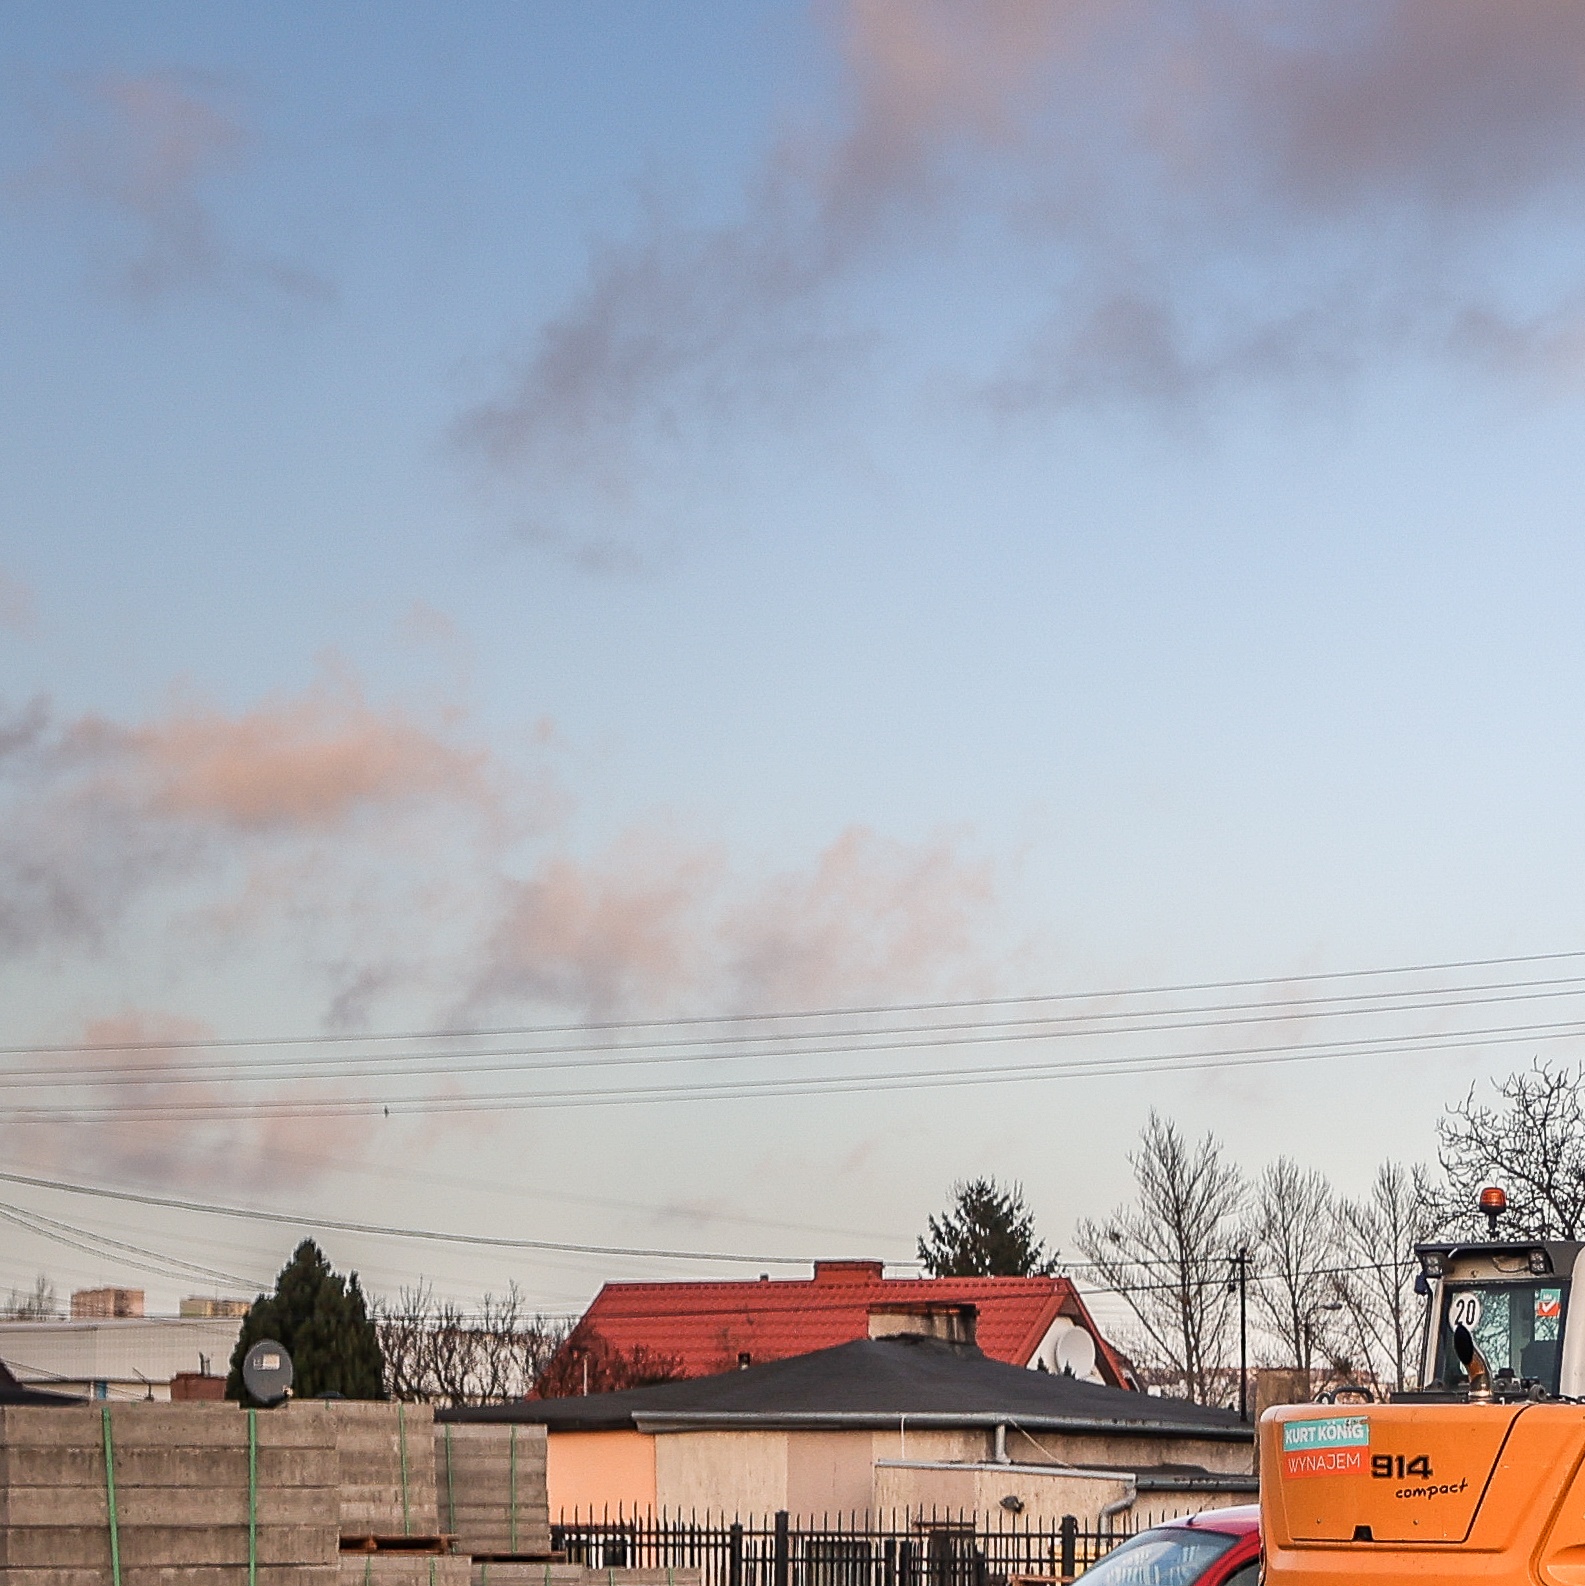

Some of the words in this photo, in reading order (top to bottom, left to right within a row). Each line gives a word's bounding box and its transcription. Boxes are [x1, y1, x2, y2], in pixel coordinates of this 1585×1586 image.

[1454, 1298, 1476, 1326] 20
[1285, 1426, 1316, 1444] KURT
[1287, 1452, 1360, 1473] WYNAJEM
[1371, 1454, 1433, 1480] 914
[1395, 1477, 1468, 1500] compact
